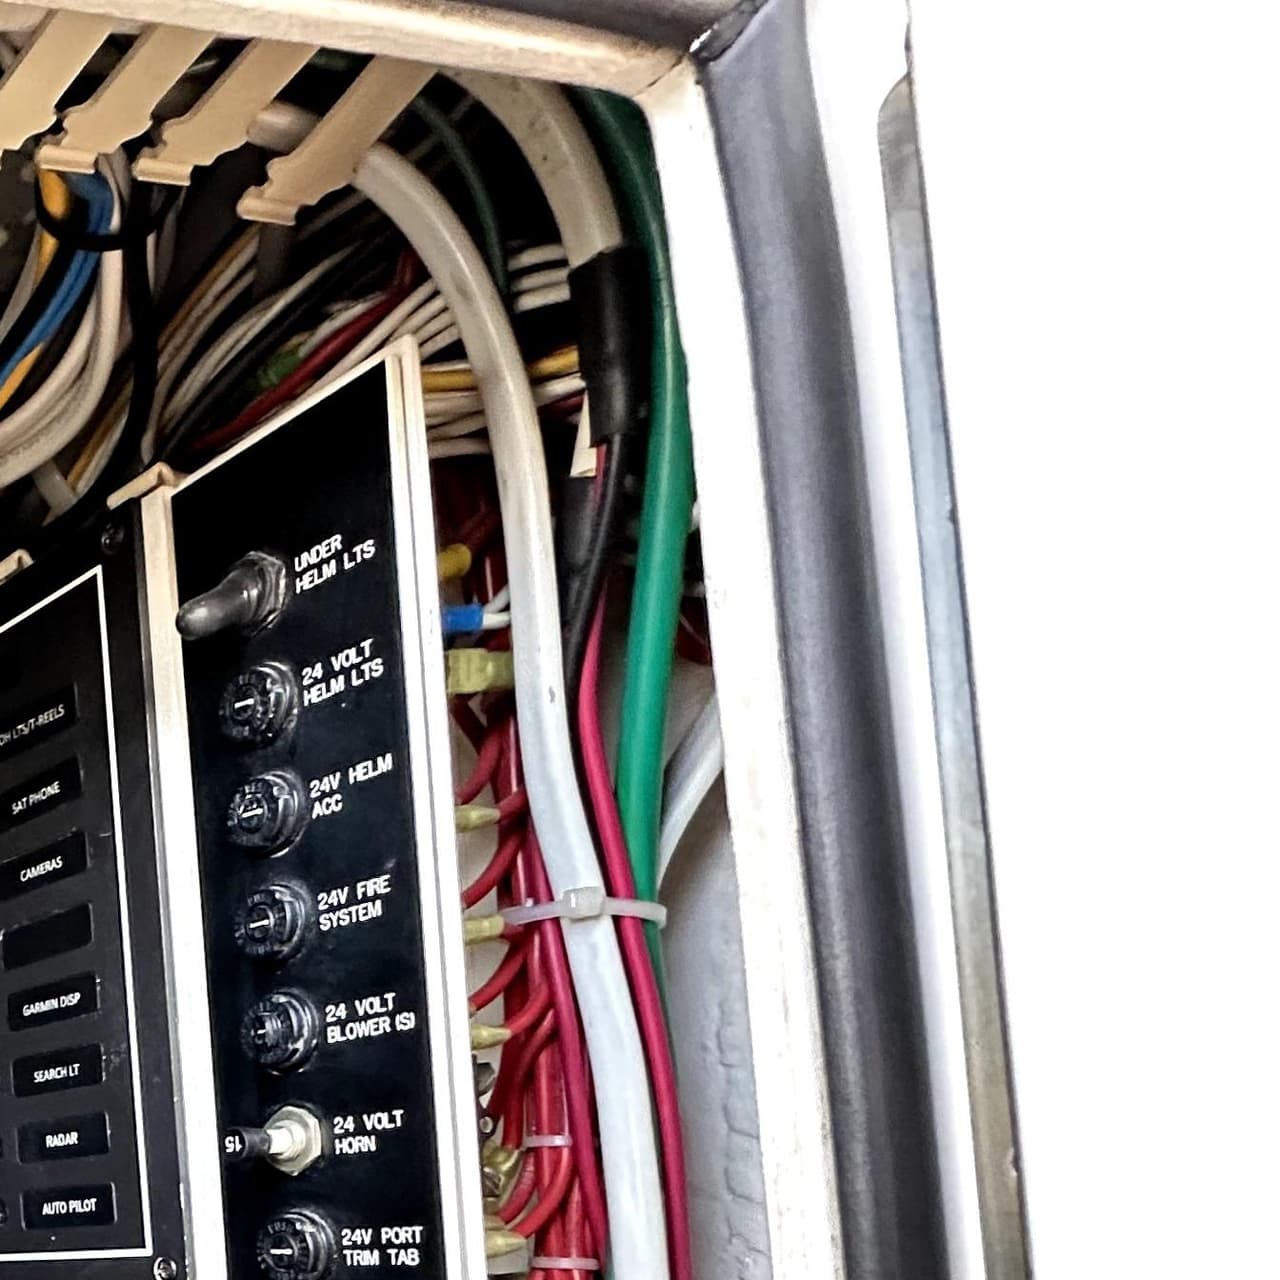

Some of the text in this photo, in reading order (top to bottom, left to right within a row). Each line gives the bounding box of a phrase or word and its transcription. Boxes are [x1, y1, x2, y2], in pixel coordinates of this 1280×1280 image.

[294, 534, 342, 572] UNDER
[295, 539, 376, 594] HELM LTS
[301, 639, 374, 685] 24 VOLT
[303, 659, 384, 707] HELM LTS
[309, 753, 393, 799] 24V HELM
[12, 781, 61, 815] SAT PHONE
[312, 794, 343, 819] ACC
[19, 856, 63, 882] CAMERAS
[317, 874, 392, 909] 24V FIRE
[319, 900, 382, 932] SYSTEM
[22, 992, 81, 1016] GARMIN DISP
[325, 993, 396, 1022] 24 VOLT
[327, 1012, 416, 1043] BLOWER (S)
[33, 1063, 81, 1083] SEARCH LT
[334, 1110, 404, 1134] 24 VOLT
[45, 1131, 78, 1148] RADAR
[225, 1136, 243, 1152] 15
[334, 1135, 377, 1155] HORN
[42, 1198, 97, 1215] AUTO PILOT
[341, 1226, 423, 1245] 24V PORT
[343, 1248, 420, 1266] TRIM TAB
